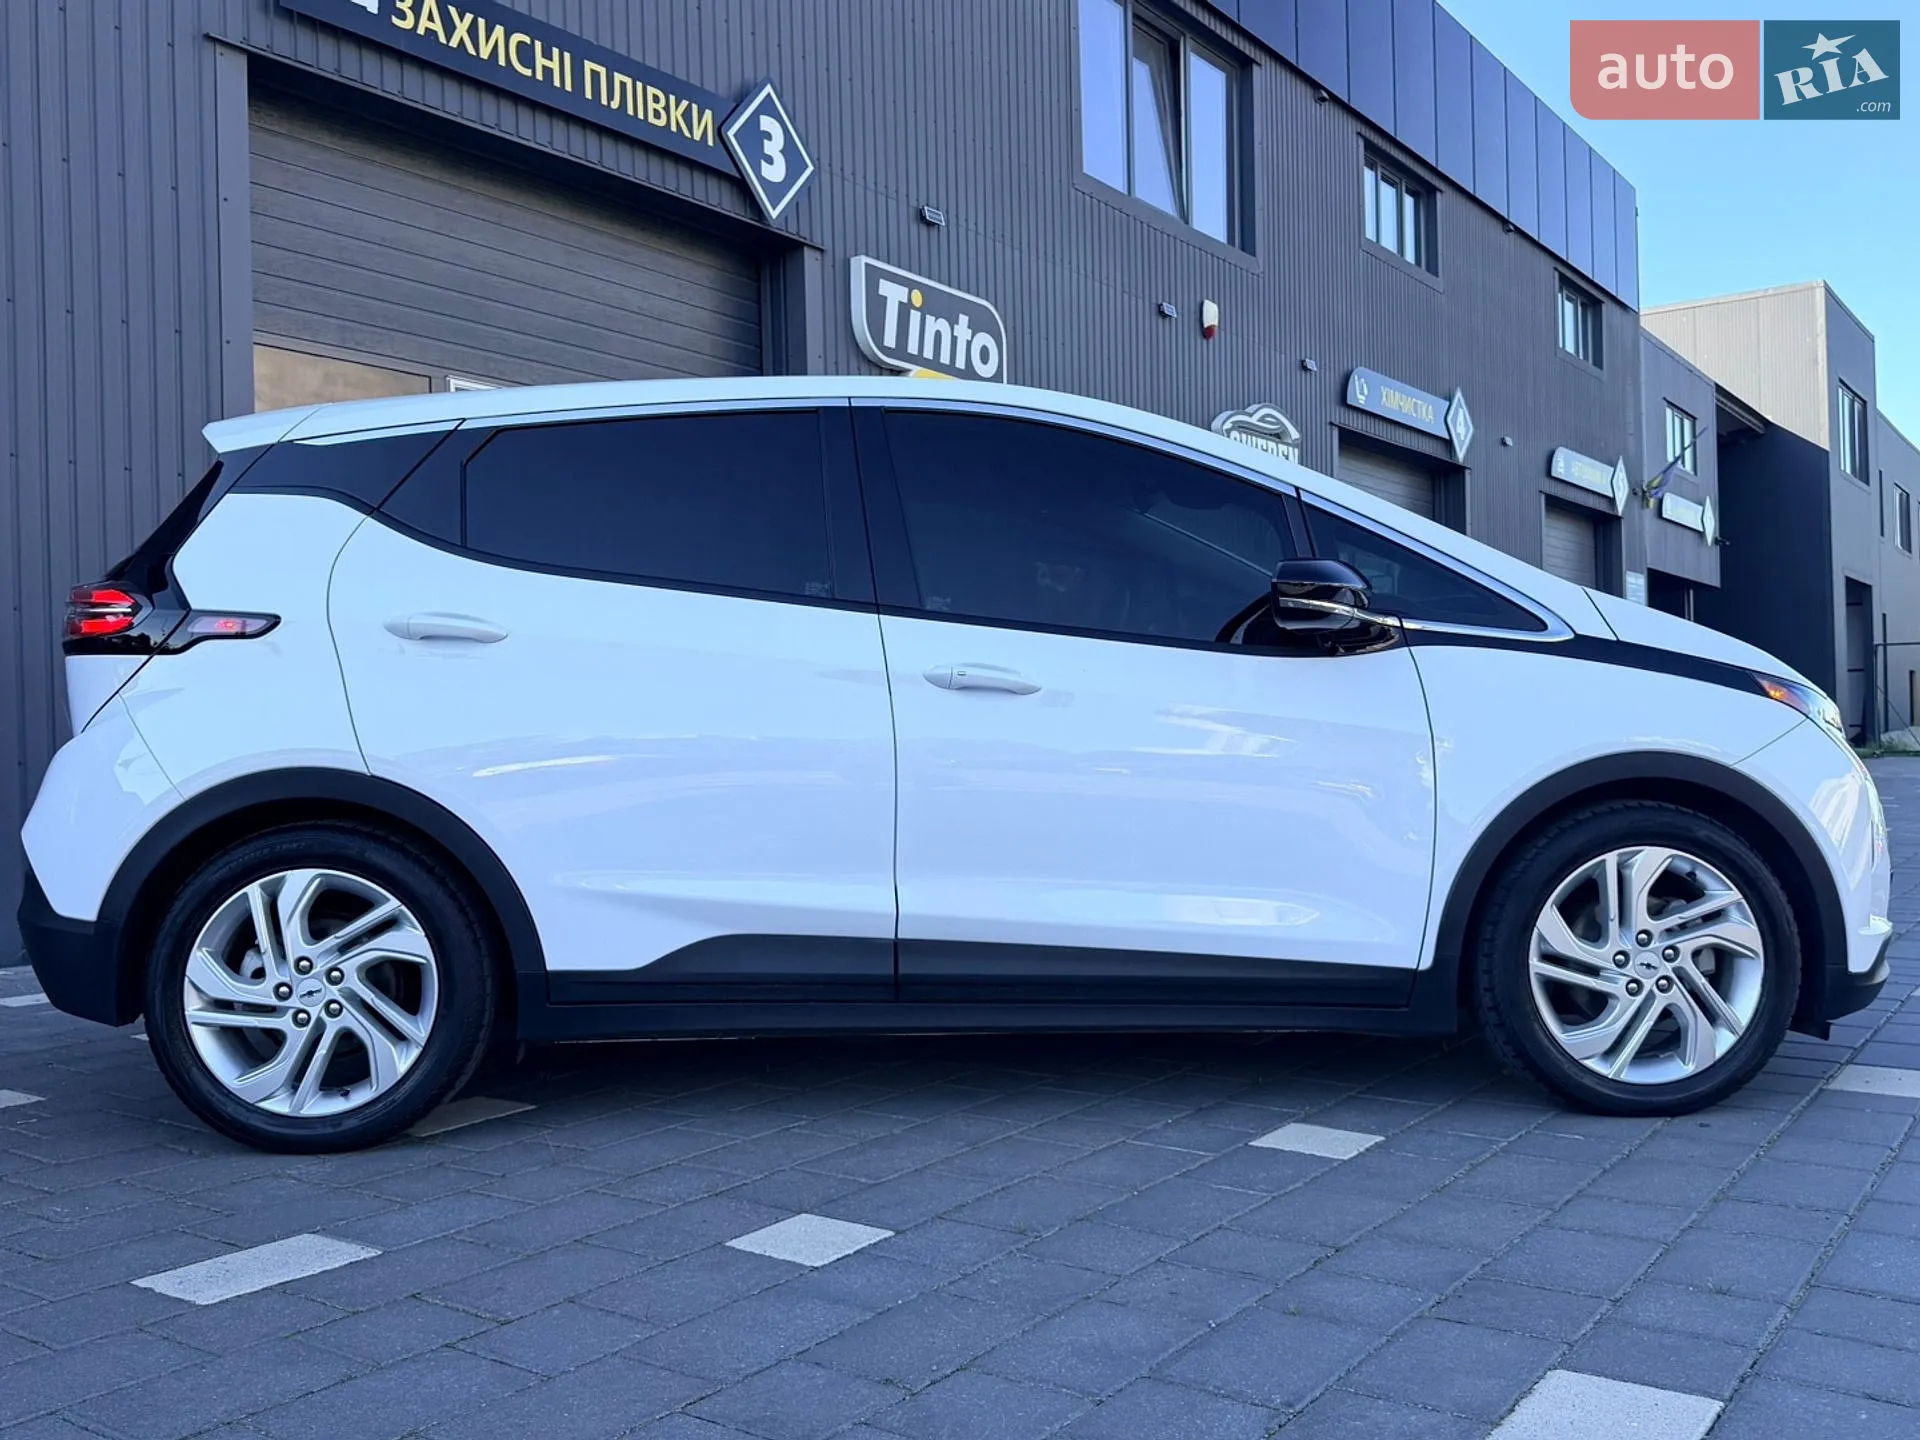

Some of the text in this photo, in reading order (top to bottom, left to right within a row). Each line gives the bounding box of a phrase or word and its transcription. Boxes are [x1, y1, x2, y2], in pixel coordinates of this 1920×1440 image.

[390, 0, 715, 148] ЗАХИСНІ ПЛІВКИ
[759, 114, 786, 184] 3
[878, 278, 1000, 379] Tinto
[1380, 385, 1434, 424] ХІМЧИСТКА
[1456, 407, 1466, 441] 4
